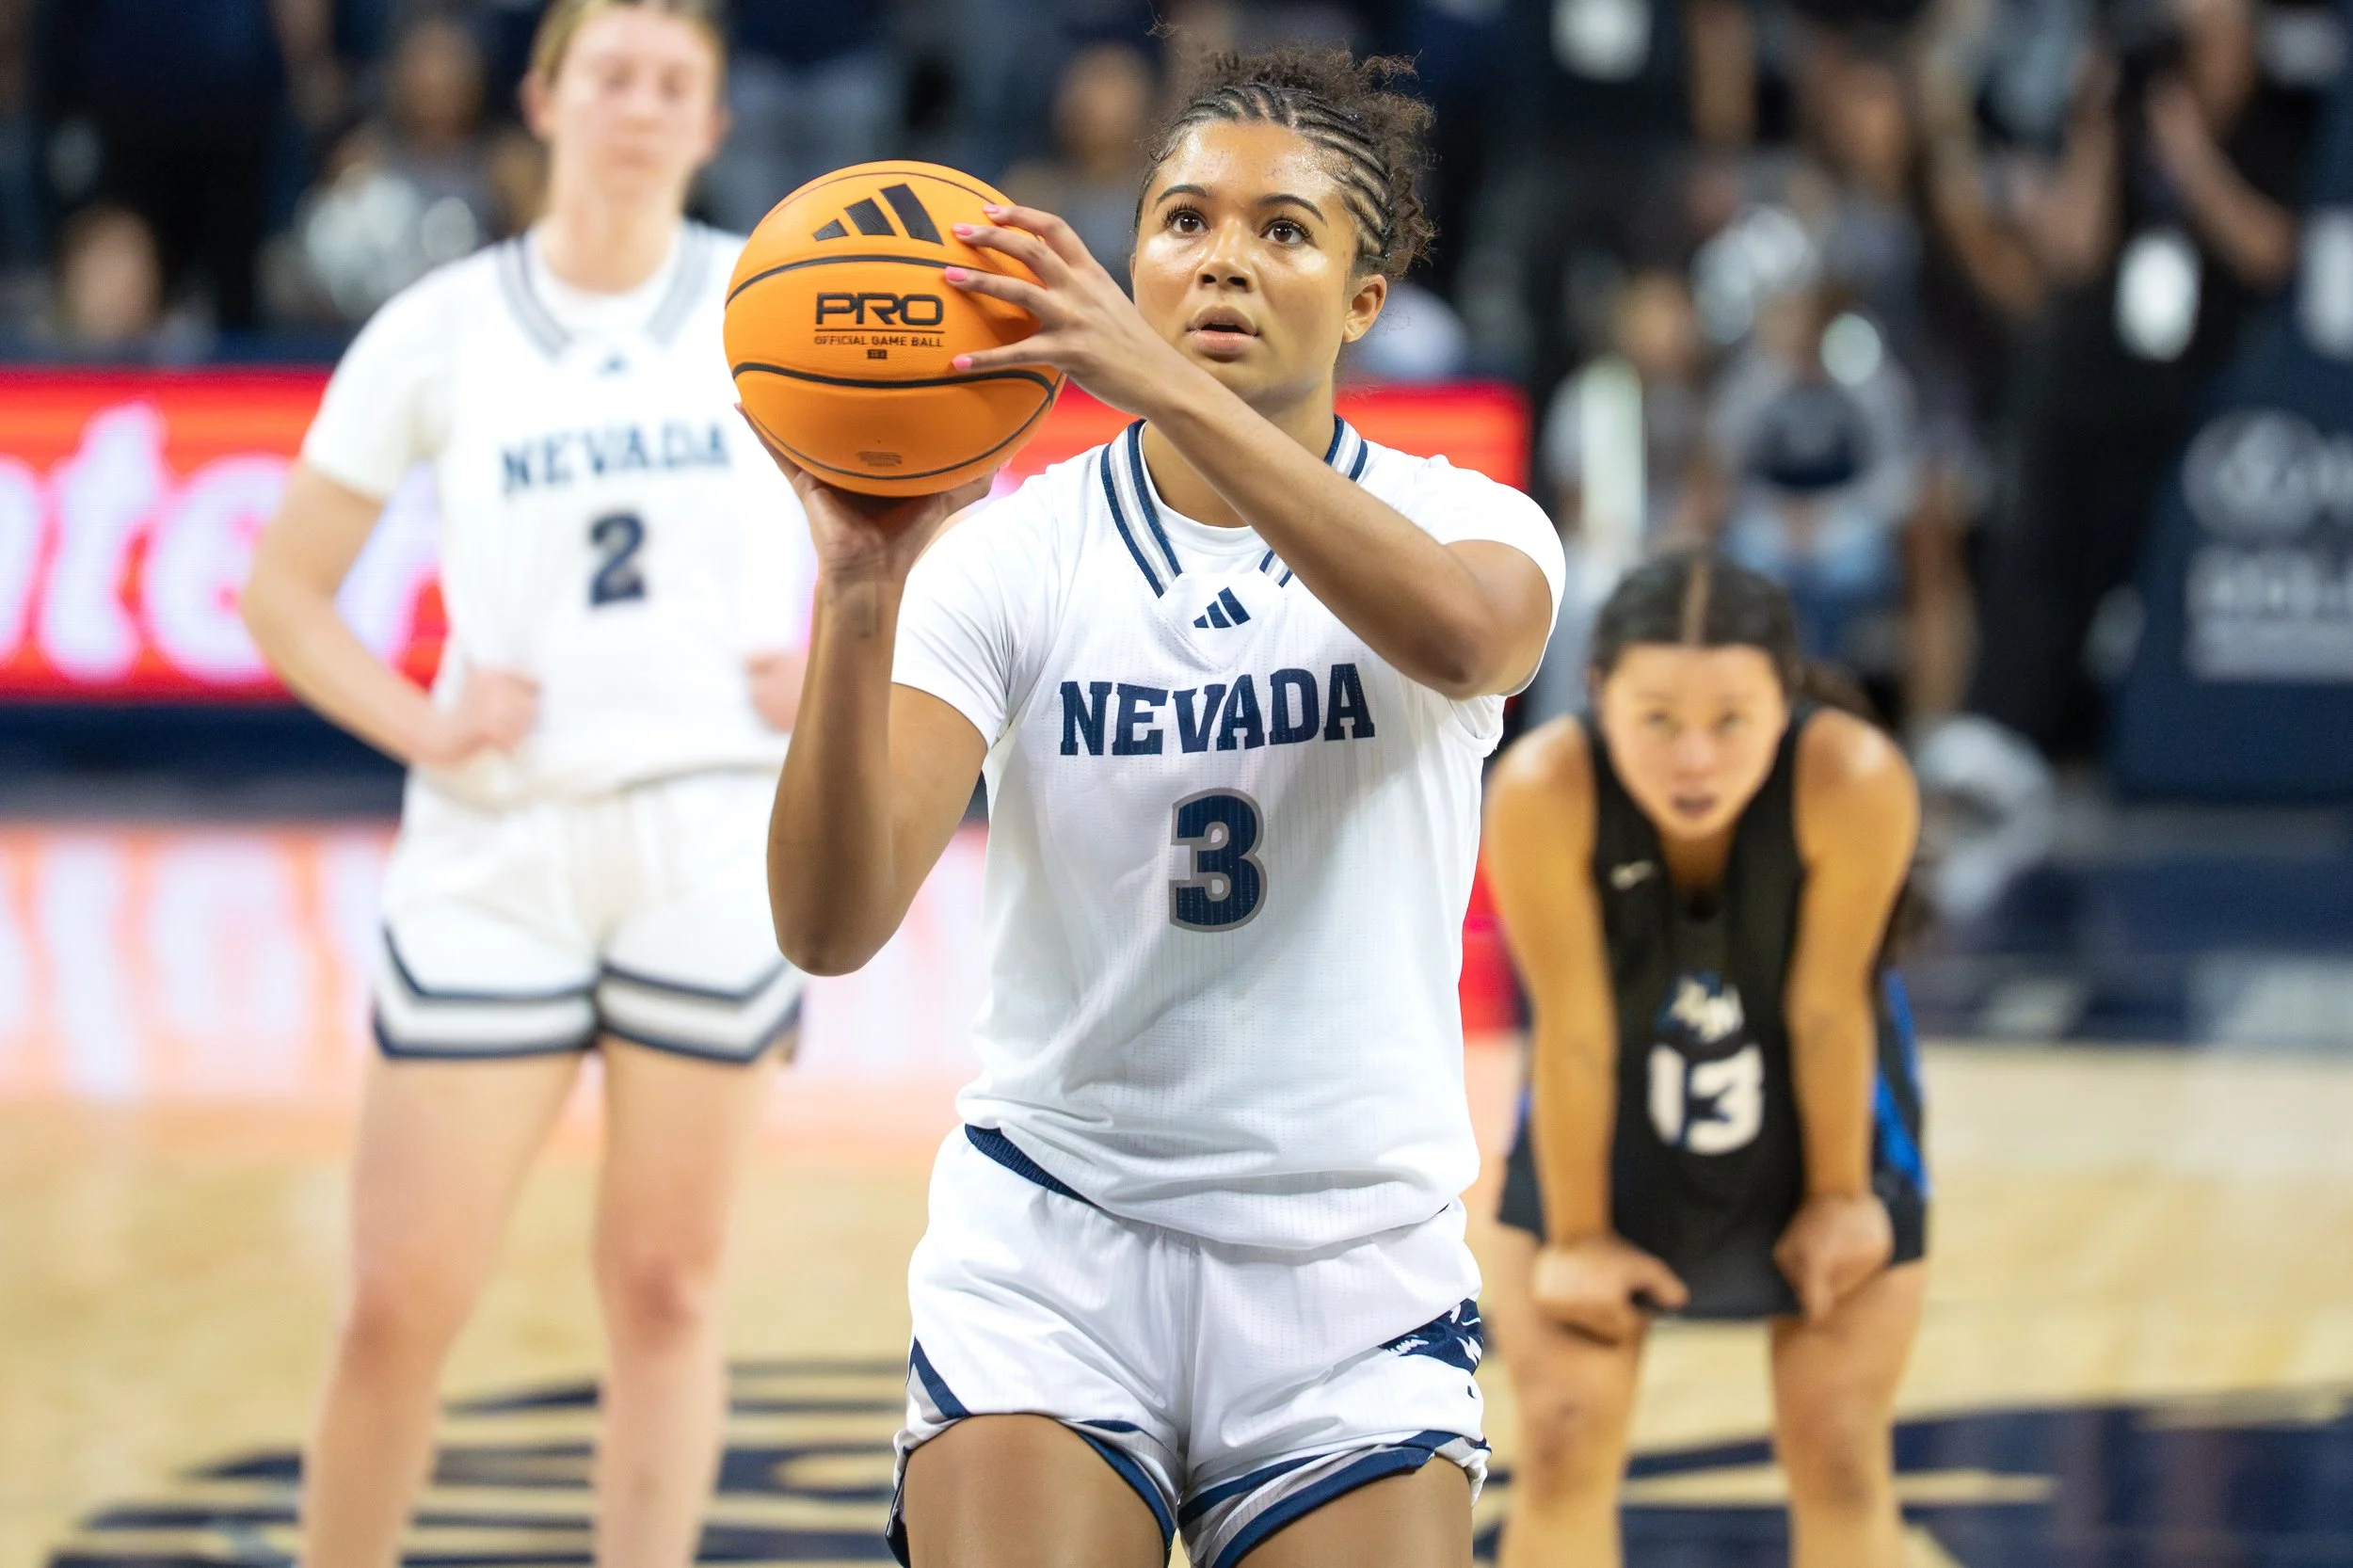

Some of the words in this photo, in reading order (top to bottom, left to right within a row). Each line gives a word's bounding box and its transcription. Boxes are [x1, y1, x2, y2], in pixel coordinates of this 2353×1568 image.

[814, 336, 867, 345] OFFICIAL
[872, 336, 907, 346] GAME
[911, 337, 943, 347] BALL
[816, 293, 943, 326] PRO
[501, 421, 733, 498] NEVADA
[587, 511, 649, 607] 2
[1060, 663, 1375, 756] NEVADA
[1168, 787, 1268, 933] 3
[1648, 1043, 1766, 1157] 13
